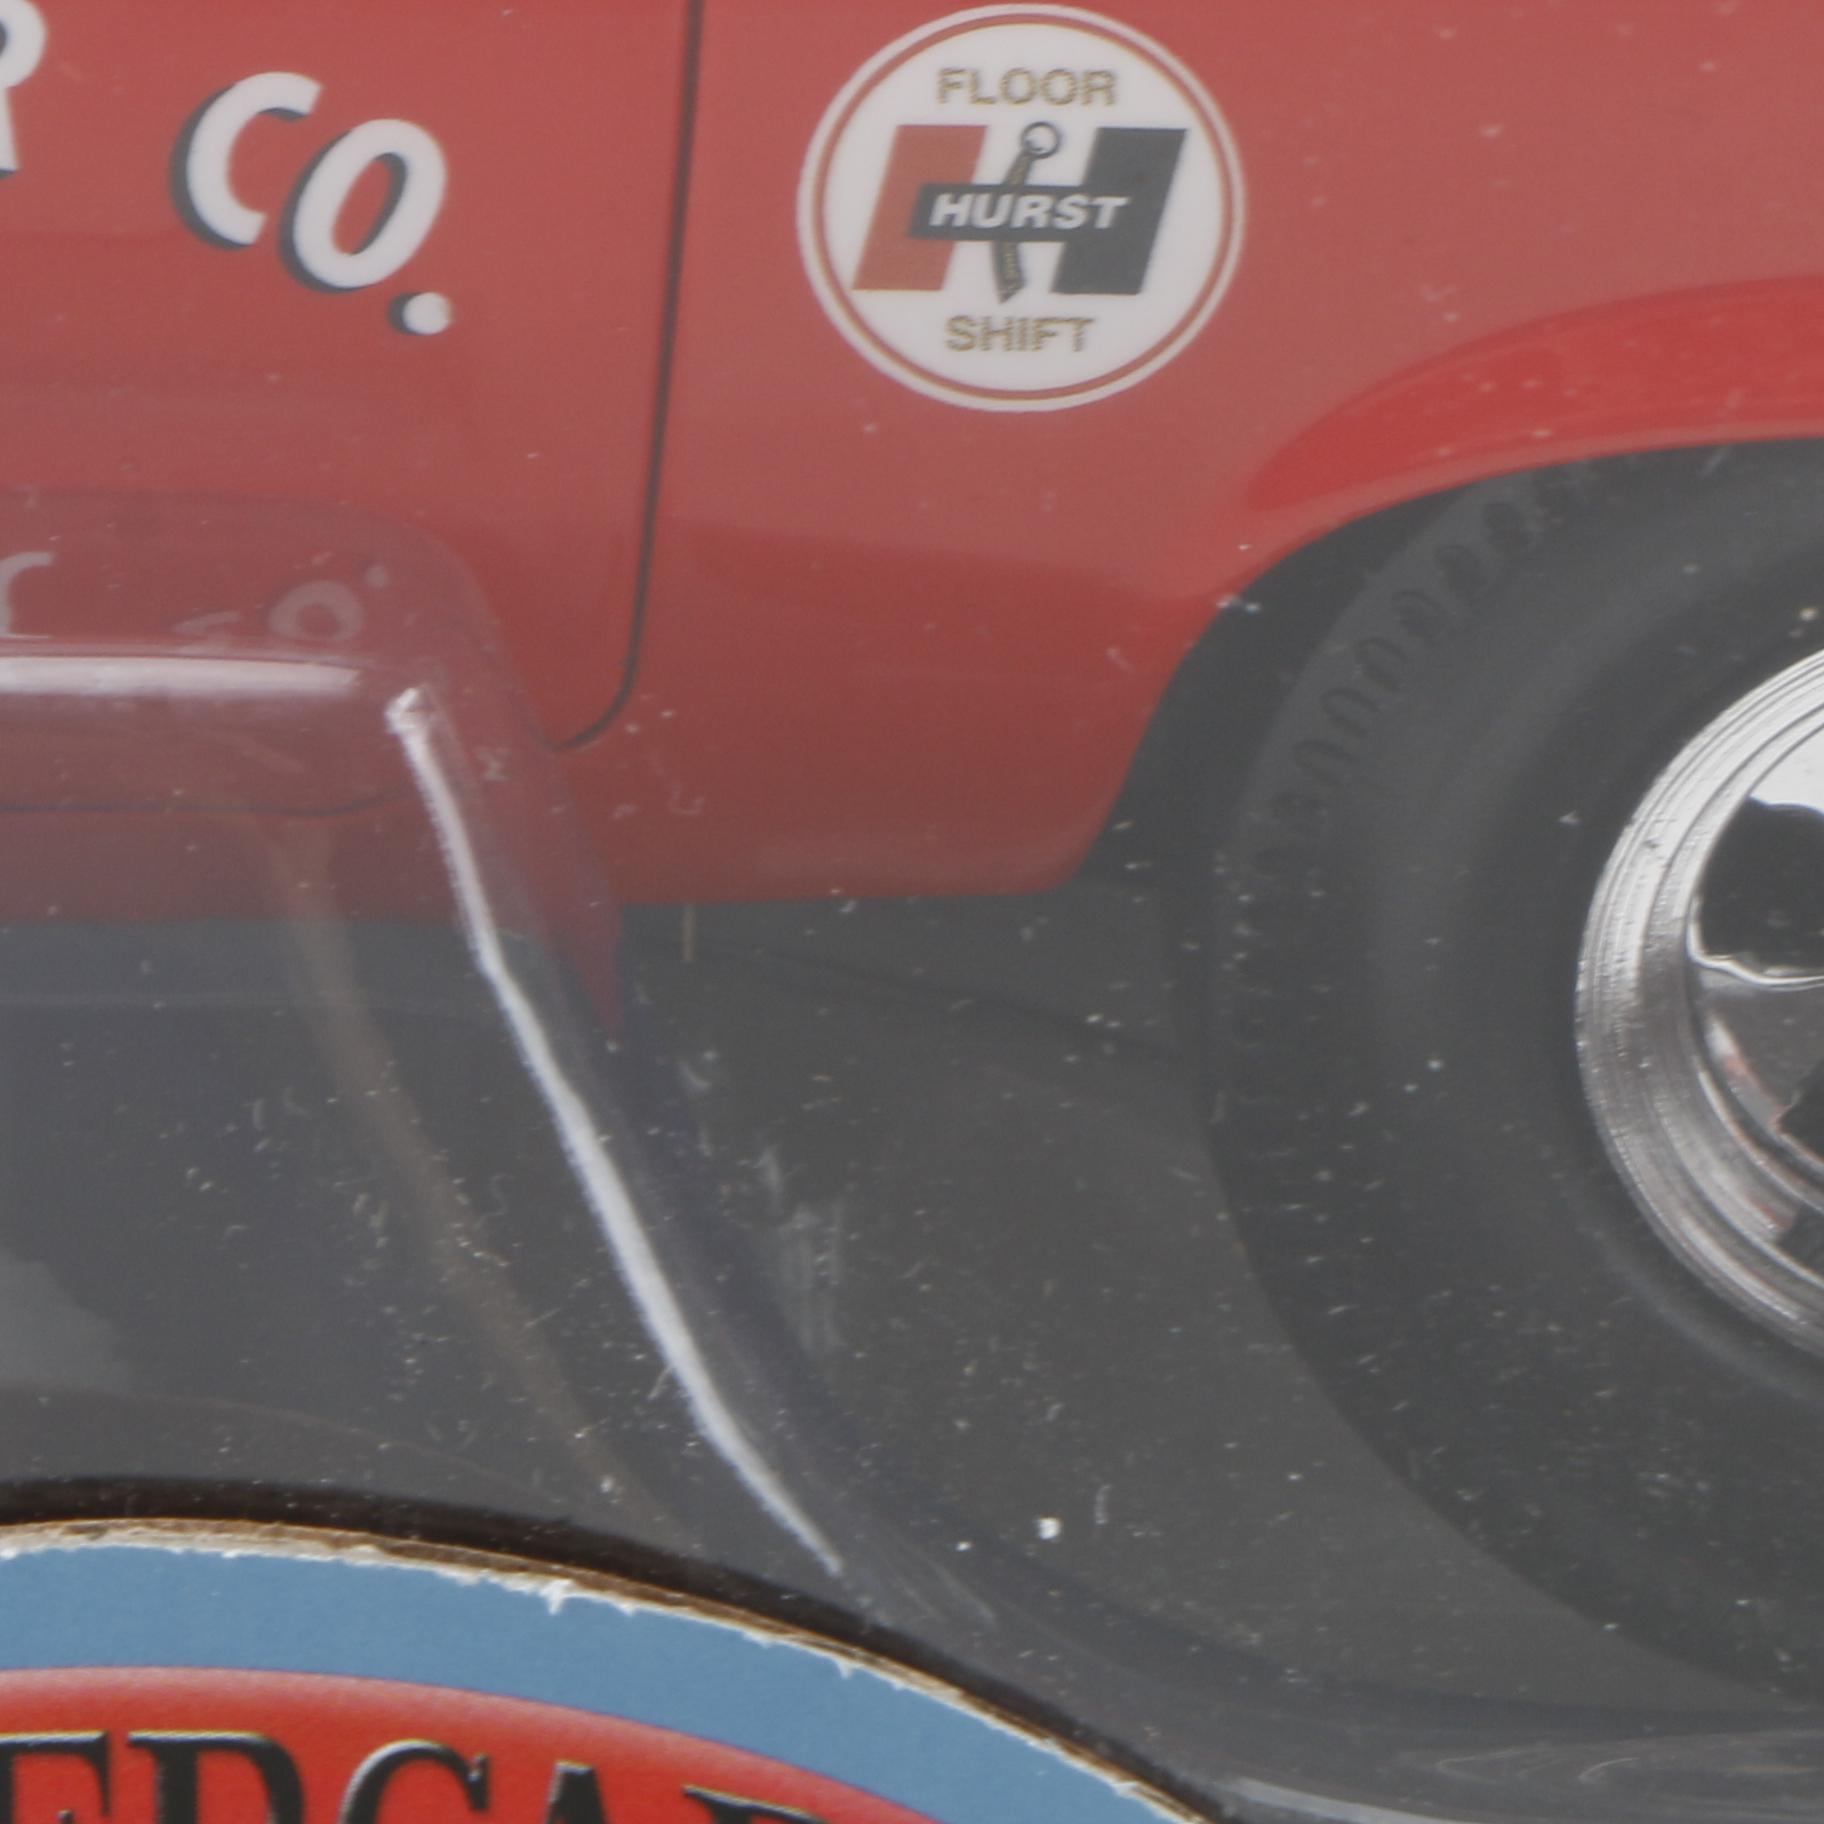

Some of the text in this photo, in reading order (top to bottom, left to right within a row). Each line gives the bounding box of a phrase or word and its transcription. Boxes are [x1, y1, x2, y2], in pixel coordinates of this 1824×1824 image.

[935, 66, 1118, 107] FLOOR
[169, 70, 453, 337] CO.
[927, 191, 1132, 230] HURST
[943, 314, 1096, 354] SHIFT
